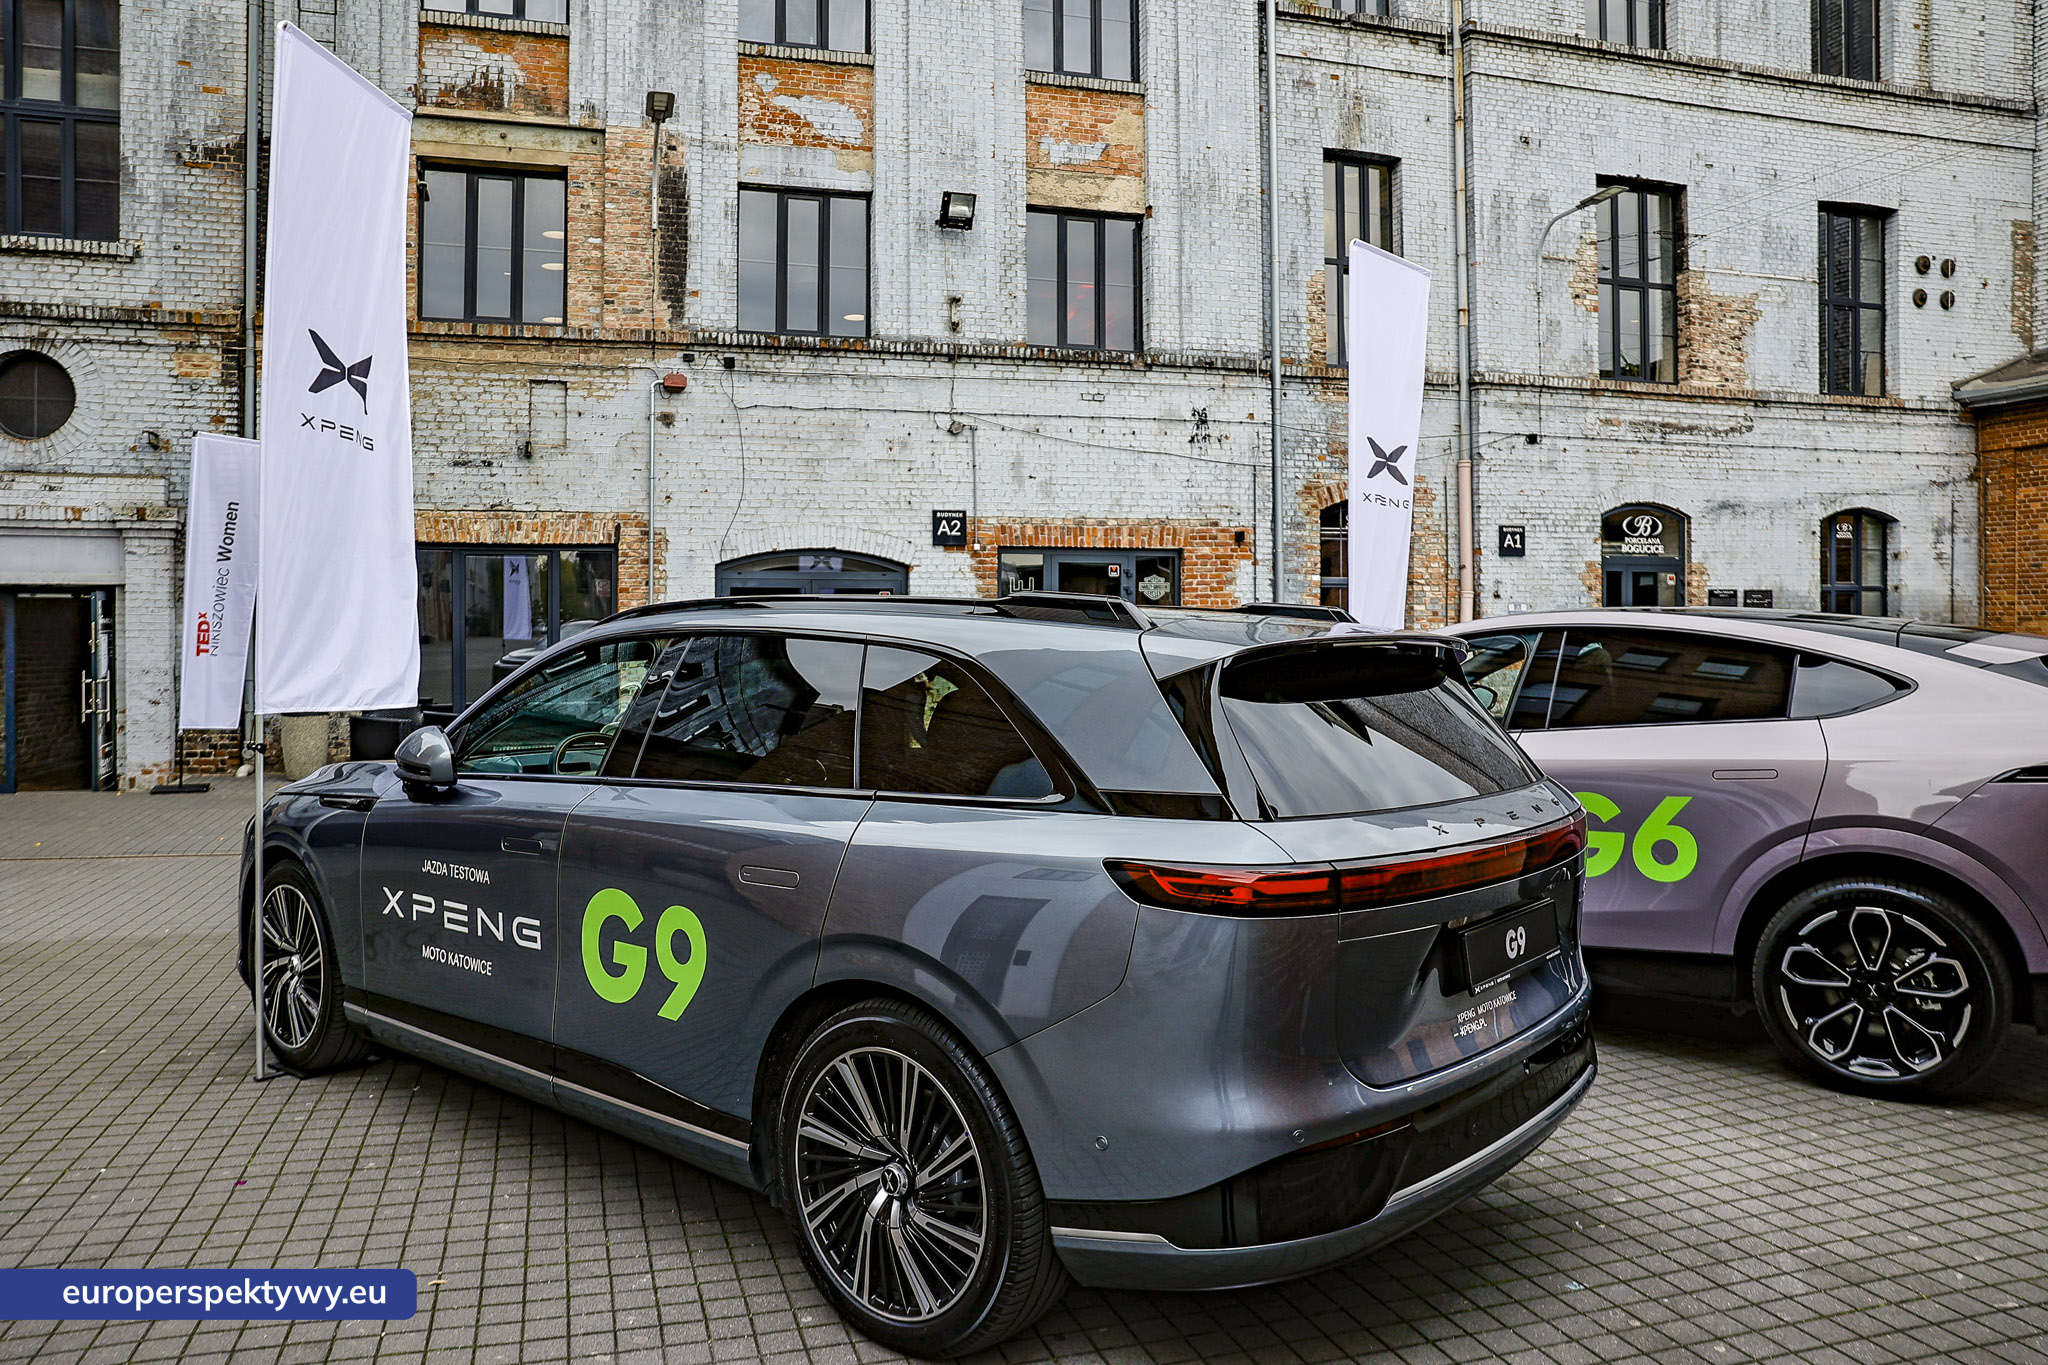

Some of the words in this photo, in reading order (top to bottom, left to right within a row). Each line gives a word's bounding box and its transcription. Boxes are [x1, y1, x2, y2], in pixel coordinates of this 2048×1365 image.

[301, 412, 374, 451] XPENG
[216, 501, 240, 562] Women
[937, 520, 961, 536] A2
[1503, 534, 1522, 548] A1
[1622, 544, 1664, 553] BOGUCICE
[196, 611, 210, 657] TEDx
[1572, 791, 1698, 883] G6
[421, 859, 448, 877] JAZDA
[449, 864, 490, 885] TESTOWA
[382, 886, 542, 950] XPENG
[422, 944, 447, 963] MOTO
[448, 951, 492, 976] KATOWICE
[581, 888, 707, 1022] G9
[1505, 926, 1526, 960] G9
[1457, 1008, 1476, 1023] XPENG
[1477, 1001, 1493, 1014] MOTO
[1492, 990, 1517, 1008] KATOWICE
